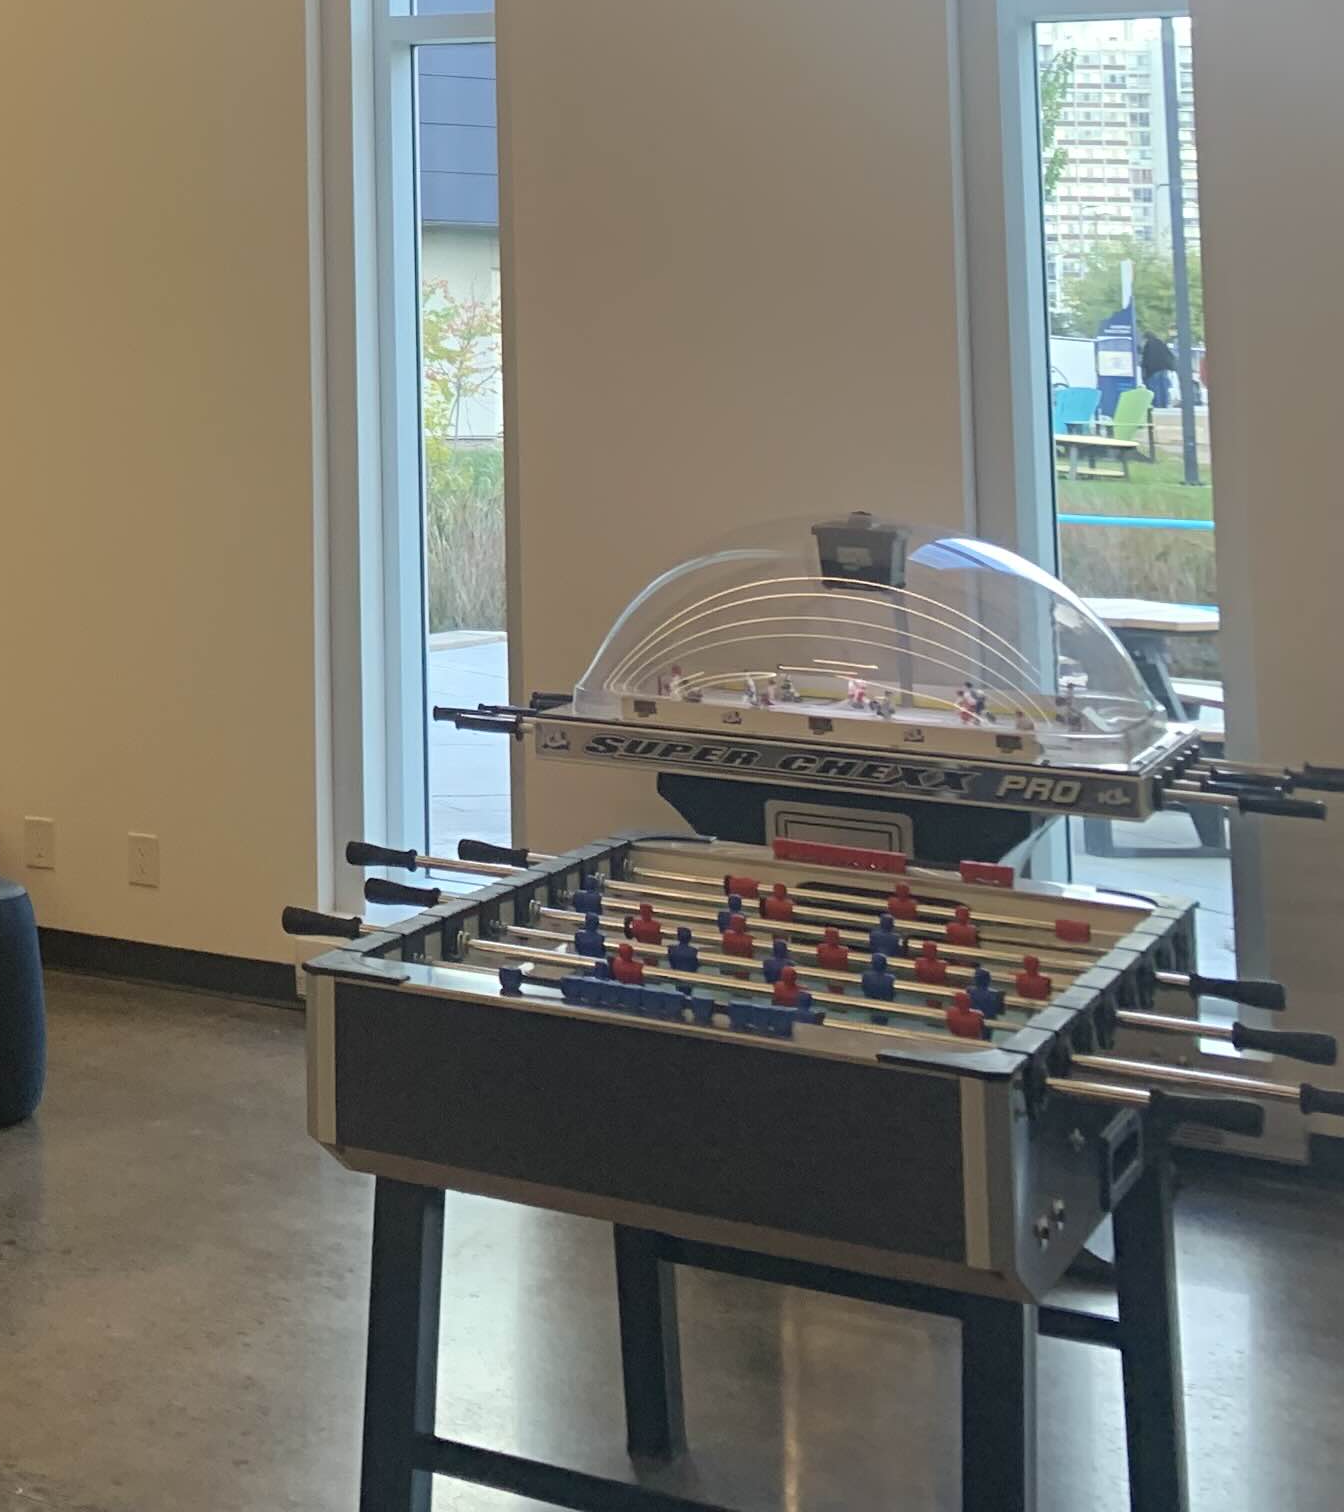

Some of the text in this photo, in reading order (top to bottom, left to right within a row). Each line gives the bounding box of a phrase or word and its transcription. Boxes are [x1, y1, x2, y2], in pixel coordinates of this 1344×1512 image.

[584, 735, 761, 767] SUPER
[776, 753, 982, 793] CHEXX
[995, 775, 1083, 804] PRO
